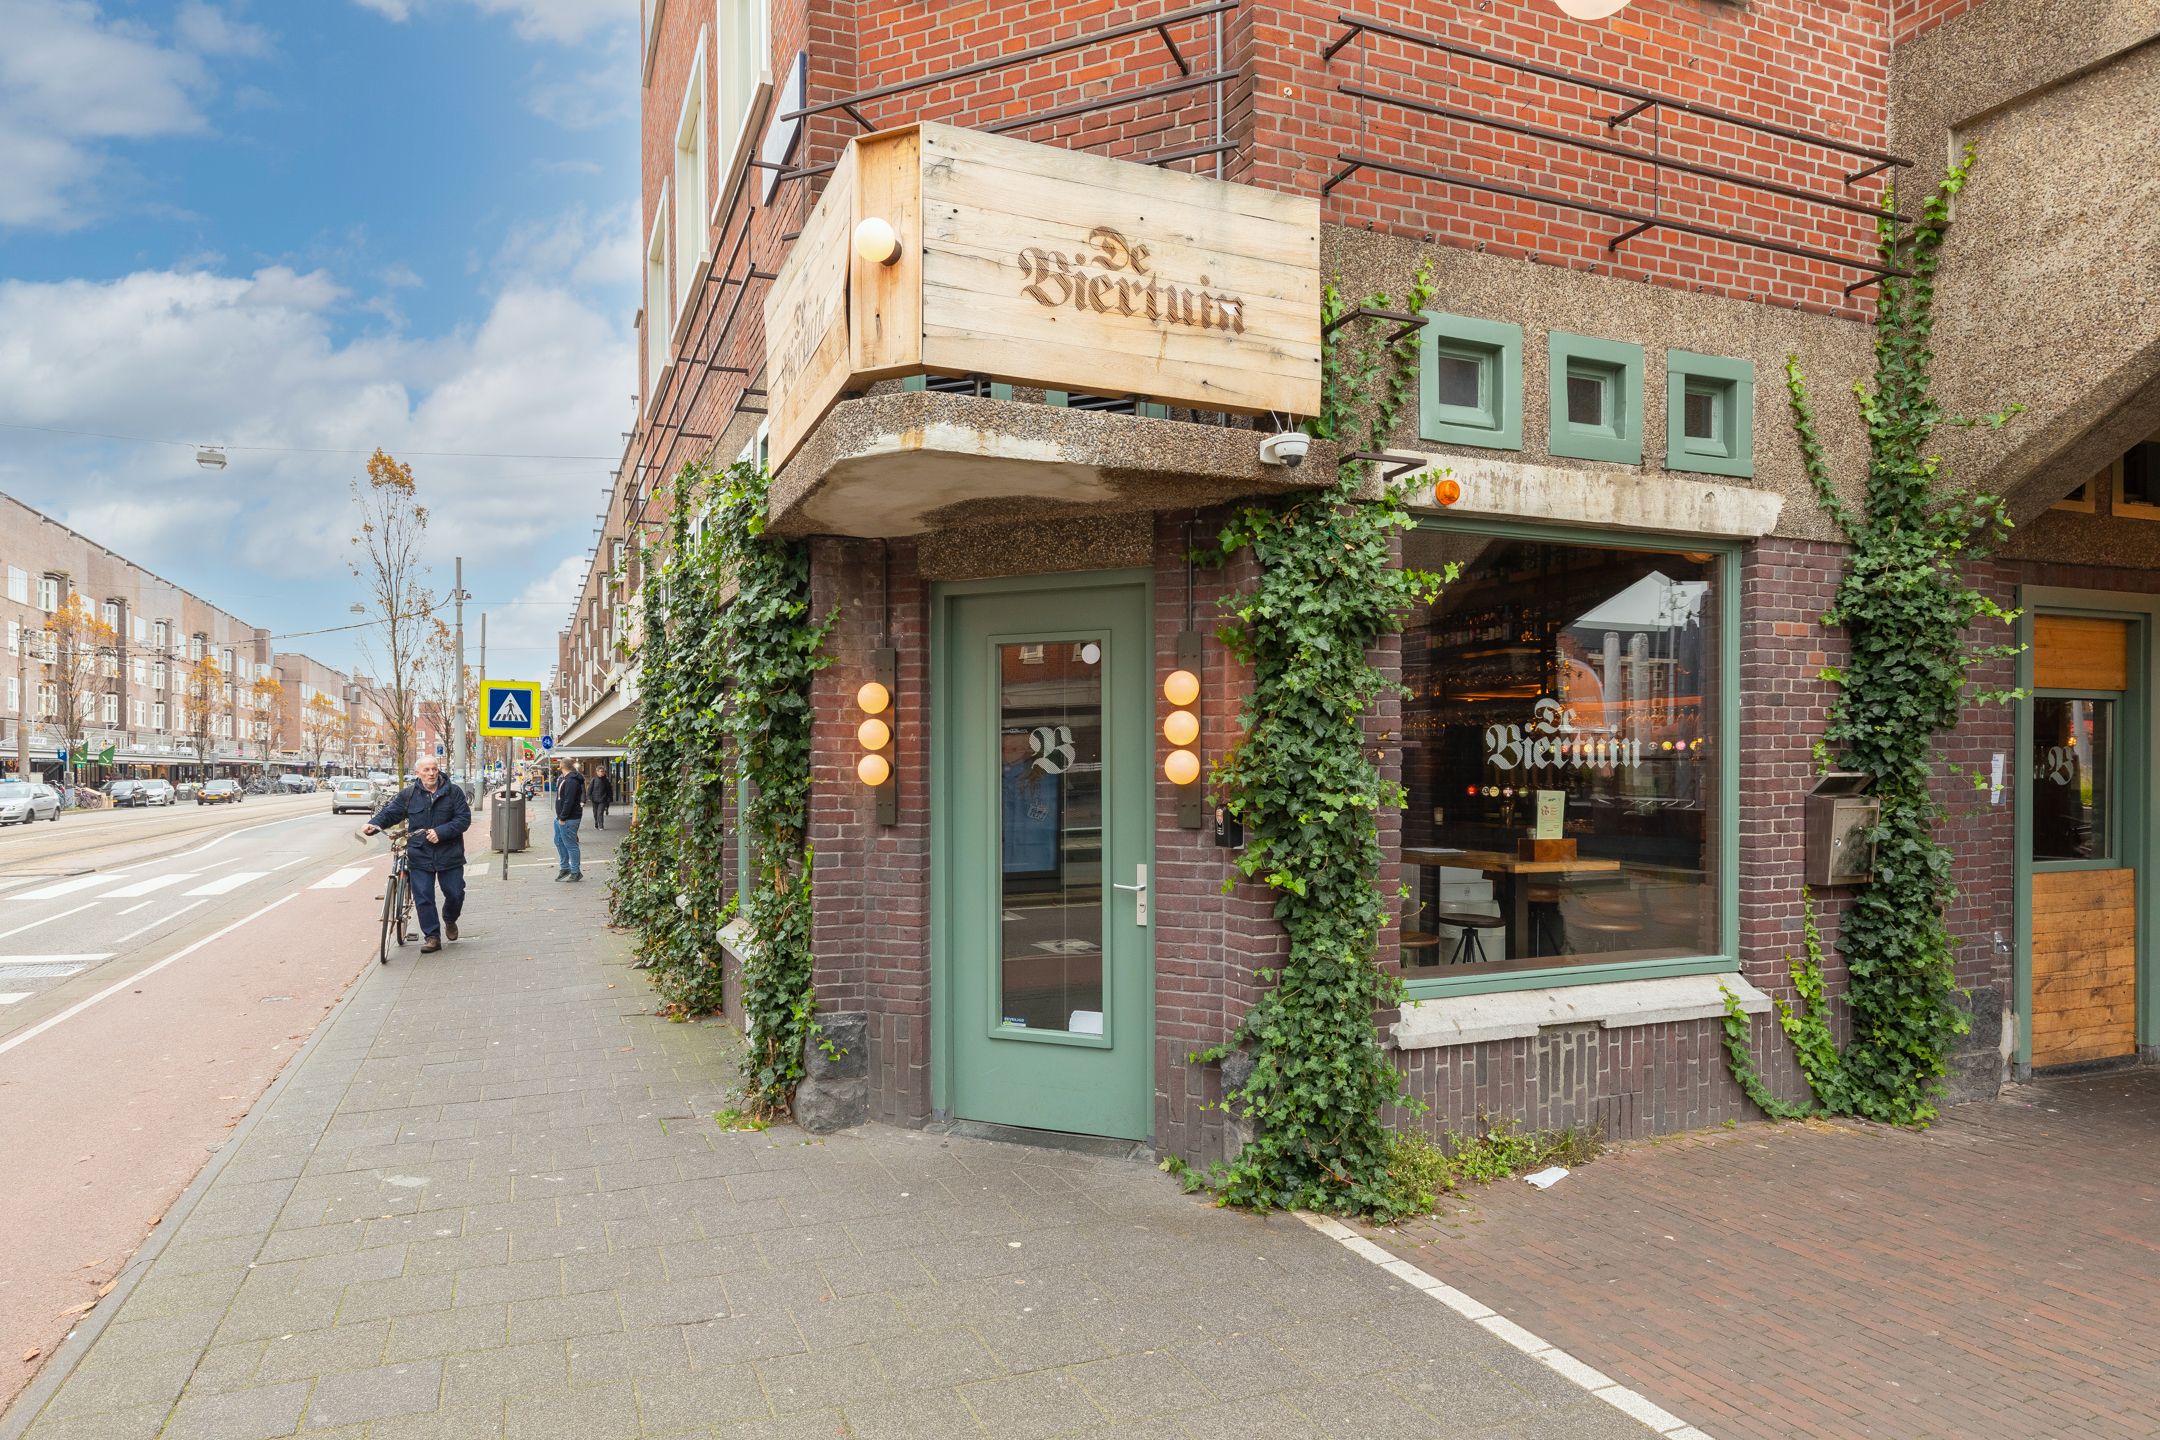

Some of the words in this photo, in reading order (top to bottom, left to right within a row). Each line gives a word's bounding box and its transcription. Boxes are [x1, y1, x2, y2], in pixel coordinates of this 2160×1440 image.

[1089, 226, 1151, 276] De
[1018, 247, 1247, 335] Biertuin
[1535, 698, 1578, 734] De
[1029, 726, 1076, 774] B
[1486, 724, 1643, 770] Biertuin
[2047, 746, 2074, 786] B
